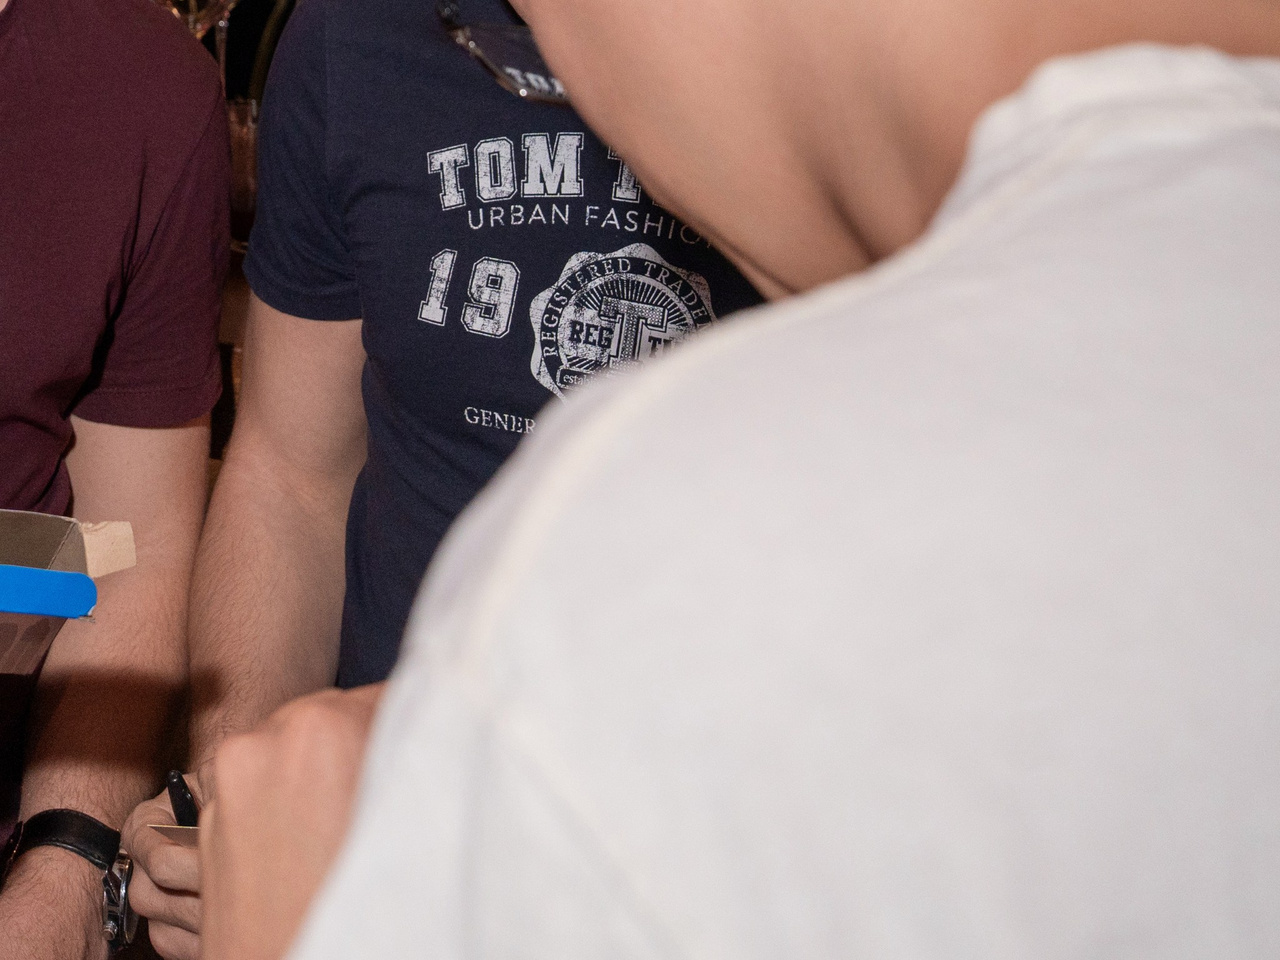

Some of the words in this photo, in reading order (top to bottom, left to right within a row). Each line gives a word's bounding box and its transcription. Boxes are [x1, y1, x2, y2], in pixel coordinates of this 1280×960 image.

[427, 132, 584, 211] TOM
[608, 146, 661, 206] T
[467, 204, 570, 230] URBAN
[585, 204, 712, 249] FASHIO
[417, 248, 521, 338] 19
[541, 258, 631, 358] REGISTERED
[569, 319, 615, 349] REG
[463, 406, 536, 434] GENER
